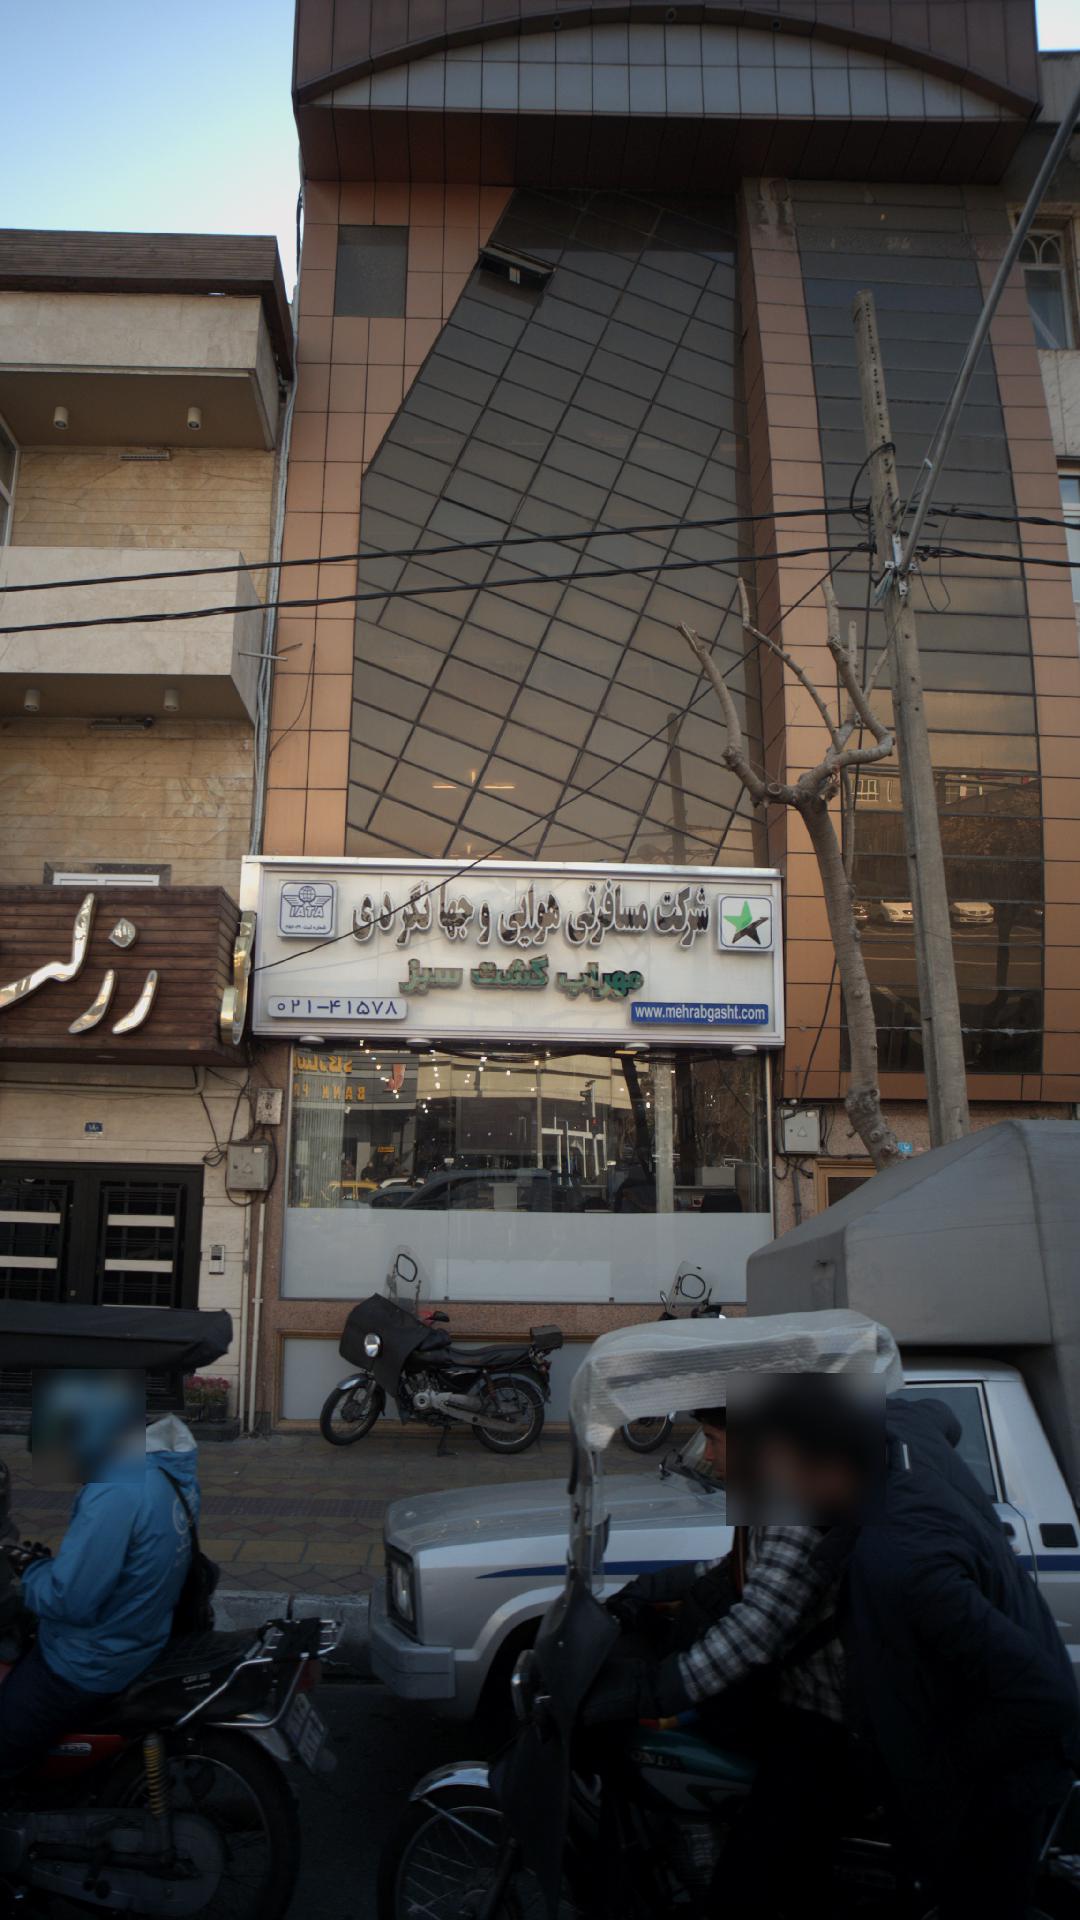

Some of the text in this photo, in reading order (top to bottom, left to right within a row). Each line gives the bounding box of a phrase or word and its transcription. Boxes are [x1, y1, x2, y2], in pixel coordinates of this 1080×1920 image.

[290, 905, 324, 918] IATA
[476, 901, 491, 945] و
[498, 880, 561, 949] هوایی
[565, 878, 650, 945] مسافرتی
[654, 885, 710, 947] شرکت
[398, 954, 645, 1001] مهراب گشت سبز
[277, 1000, 397, 1015] ۰۲۱-۴۱۵۷۸
[635, 1004, 766, 1022] www.mehrabgasht.com
